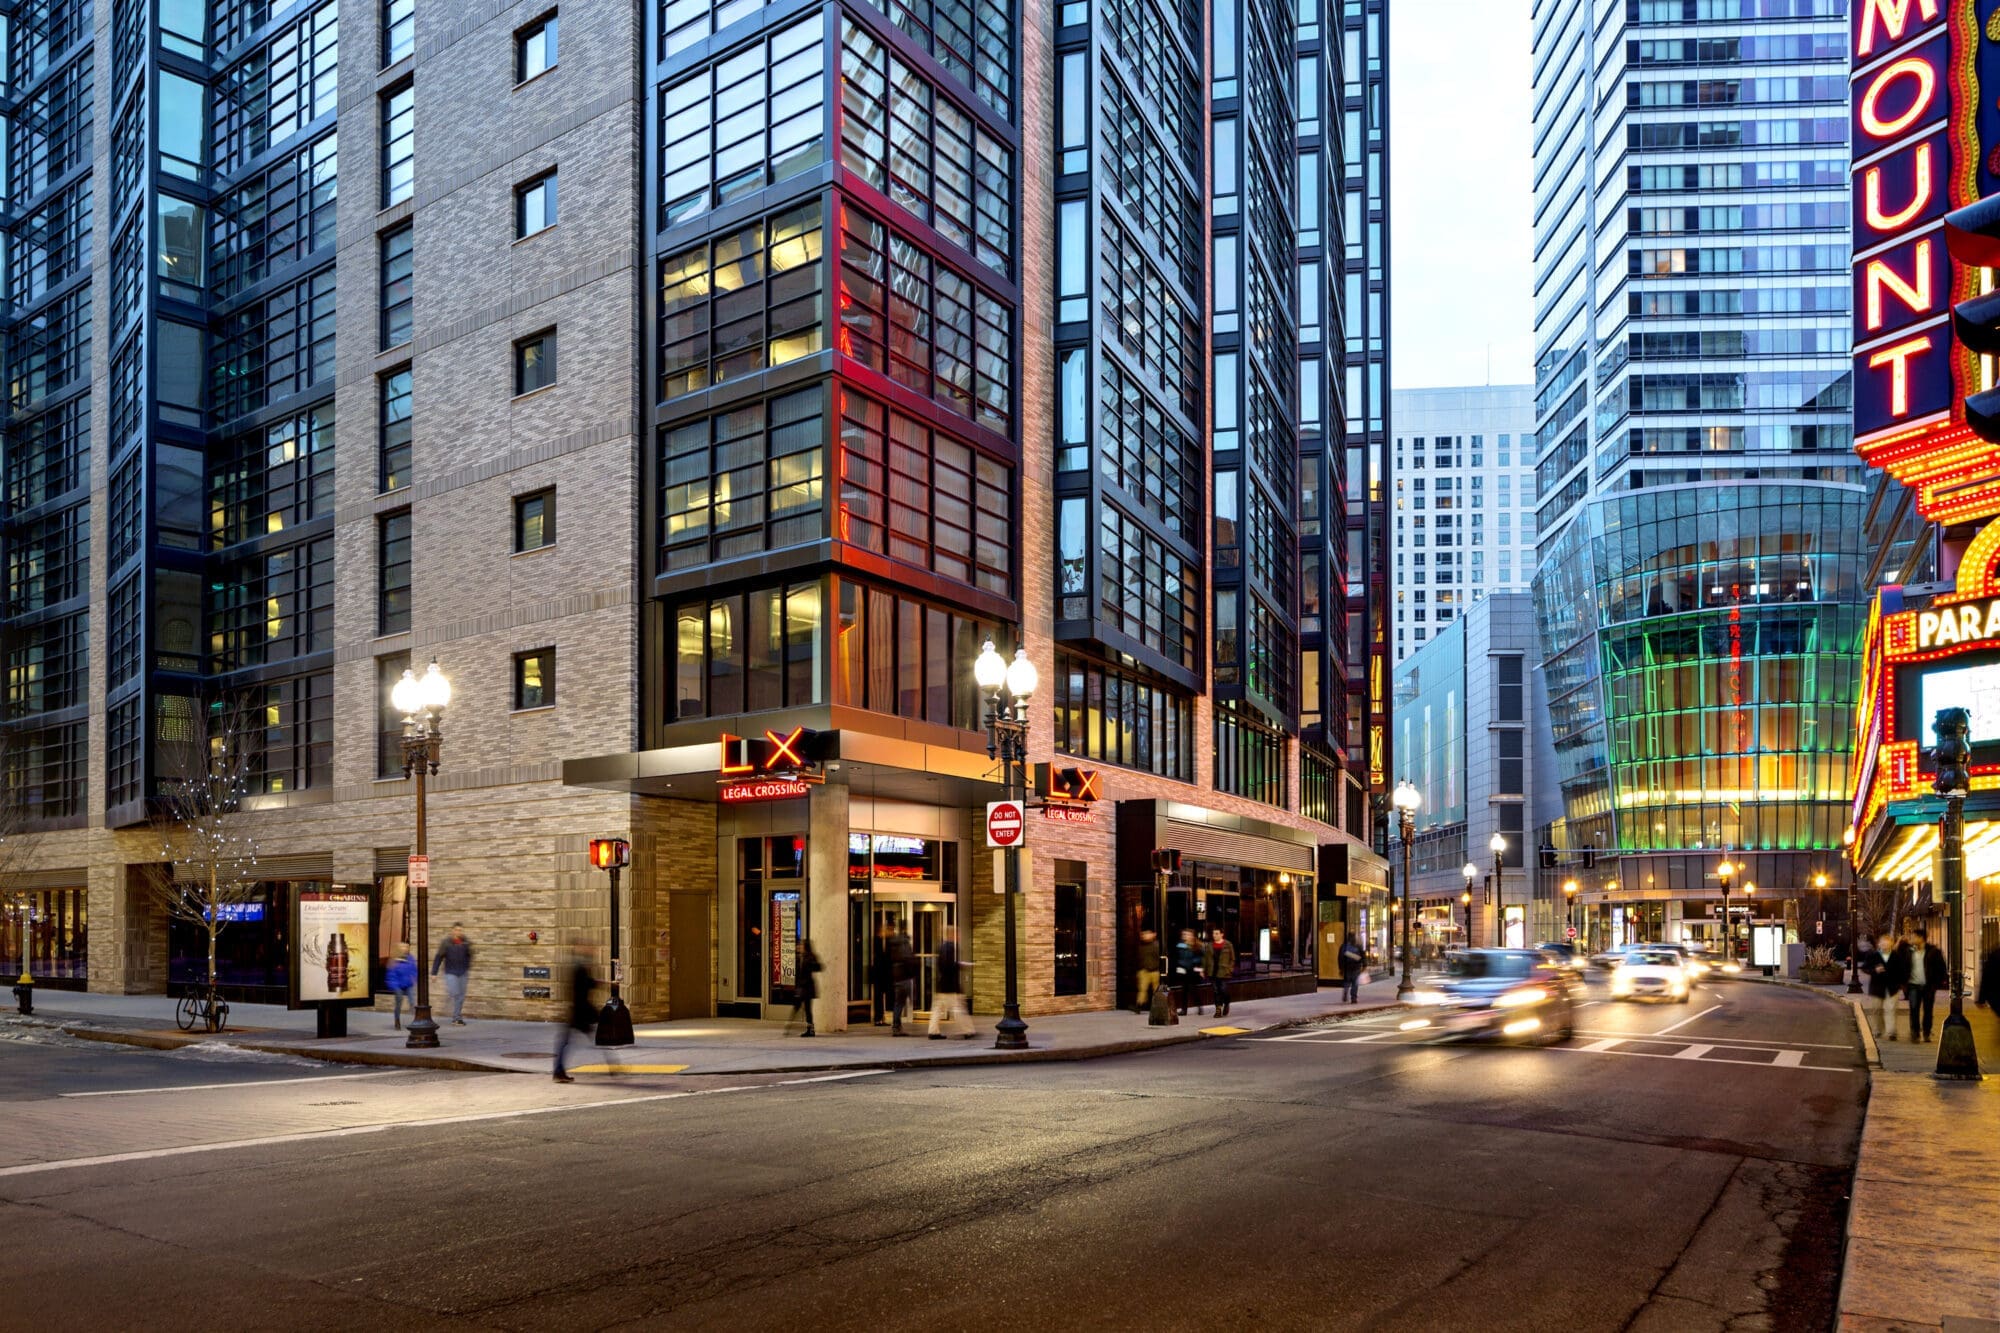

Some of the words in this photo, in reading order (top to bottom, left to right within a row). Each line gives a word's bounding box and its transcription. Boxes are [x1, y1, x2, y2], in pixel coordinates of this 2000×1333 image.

[723, 787, 754, 800] LEGAL
[755, 782, 806, 797] CROSSING
[1004, 811, 1017, 819] NOT
[1047, 808, 1066, 820] LEGAL
[1067, 810, 1097, 823] CROSSING
[995, 830, 1015, 838] ENTER
